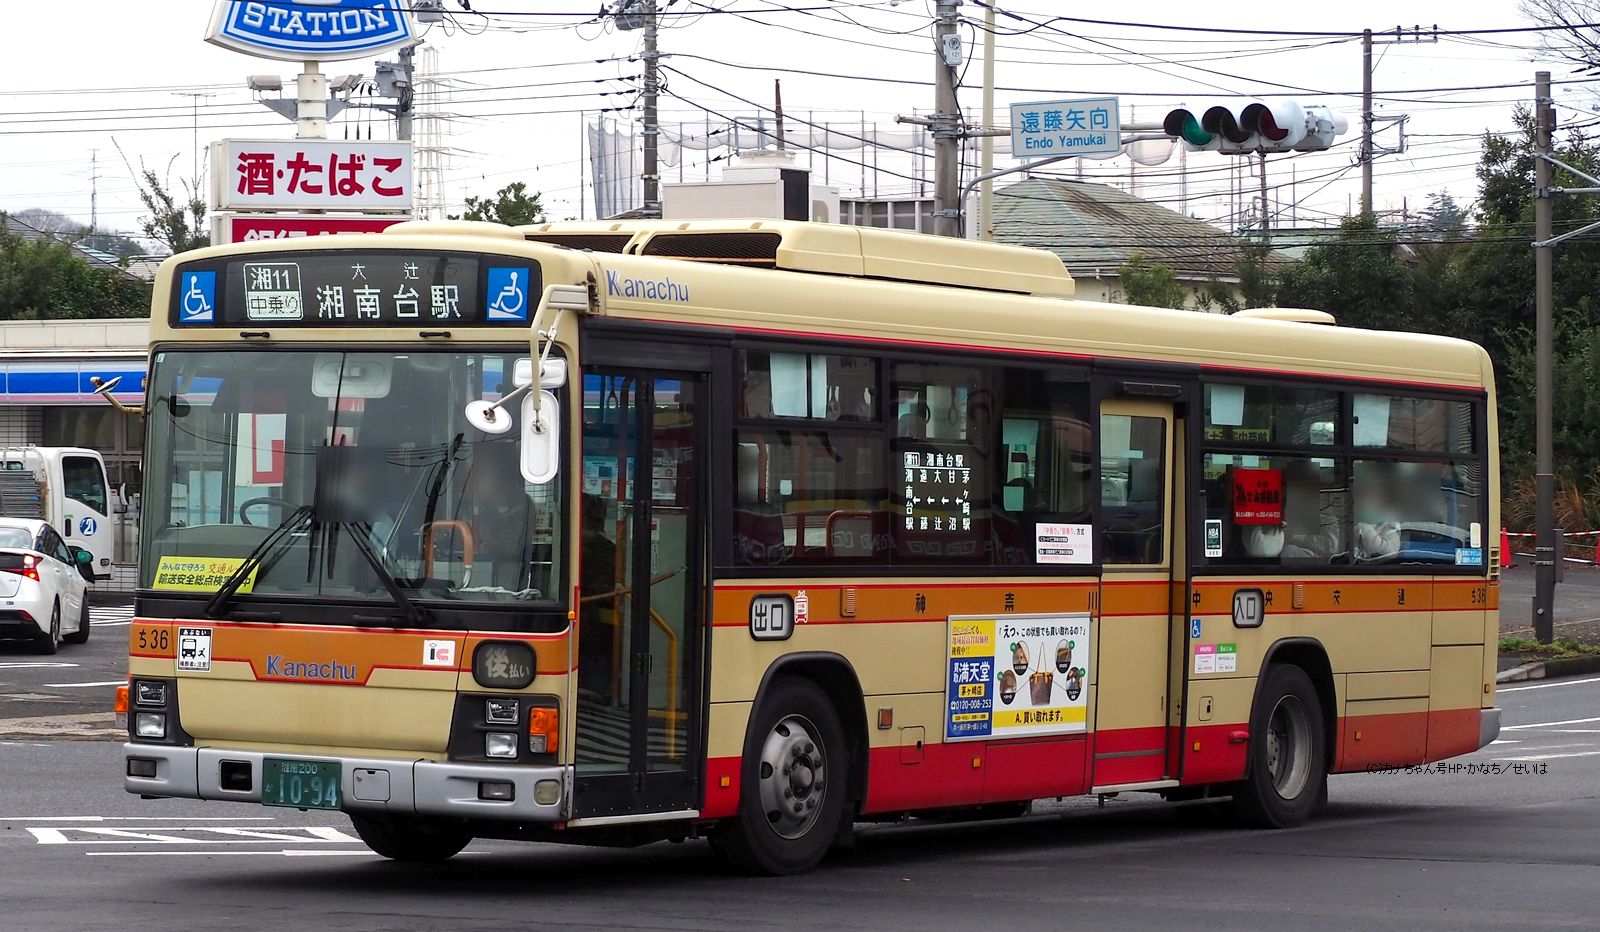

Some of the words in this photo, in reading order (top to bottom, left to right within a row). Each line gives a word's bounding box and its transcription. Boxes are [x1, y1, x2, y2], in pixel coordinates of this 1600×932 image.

[242, 3, 390, 36] STATION
[1020, 106, 1109, 134] 遠藤矢向
[1025, 137, 1053, 149] Endo
[1059, 133, 1106, 147] Yamukai
[237, 151, 404, 197] 酒・たばこ
[250, 266, 290, 291] 湘11
[606, 269, 689, 302] Kanachu
[250, 295, 299, 316] 中乗り
[315, 283, 462, 320] 湘南台駅
[926, 452, 964, 467] 湘南台駅
[905, 468, 914, 530] 湘南台駅
[158, 573, 251, 588] 輸送安全総点検中
[161, 562, 205, 572] みんなで守ろう
[208, 562, 239, 574] 交通ル
[754, 602, 784, 632] 出口
[1235, 596, 1256, 620] 入口
[138, 628, 169, 650] ち36
[266, 655, 355, 680] Kanachu
[485, 648, 530, 680] 後払い
[959, 661, 990, 682] 満天堂
[279, 773, 337, 806] 10-94
